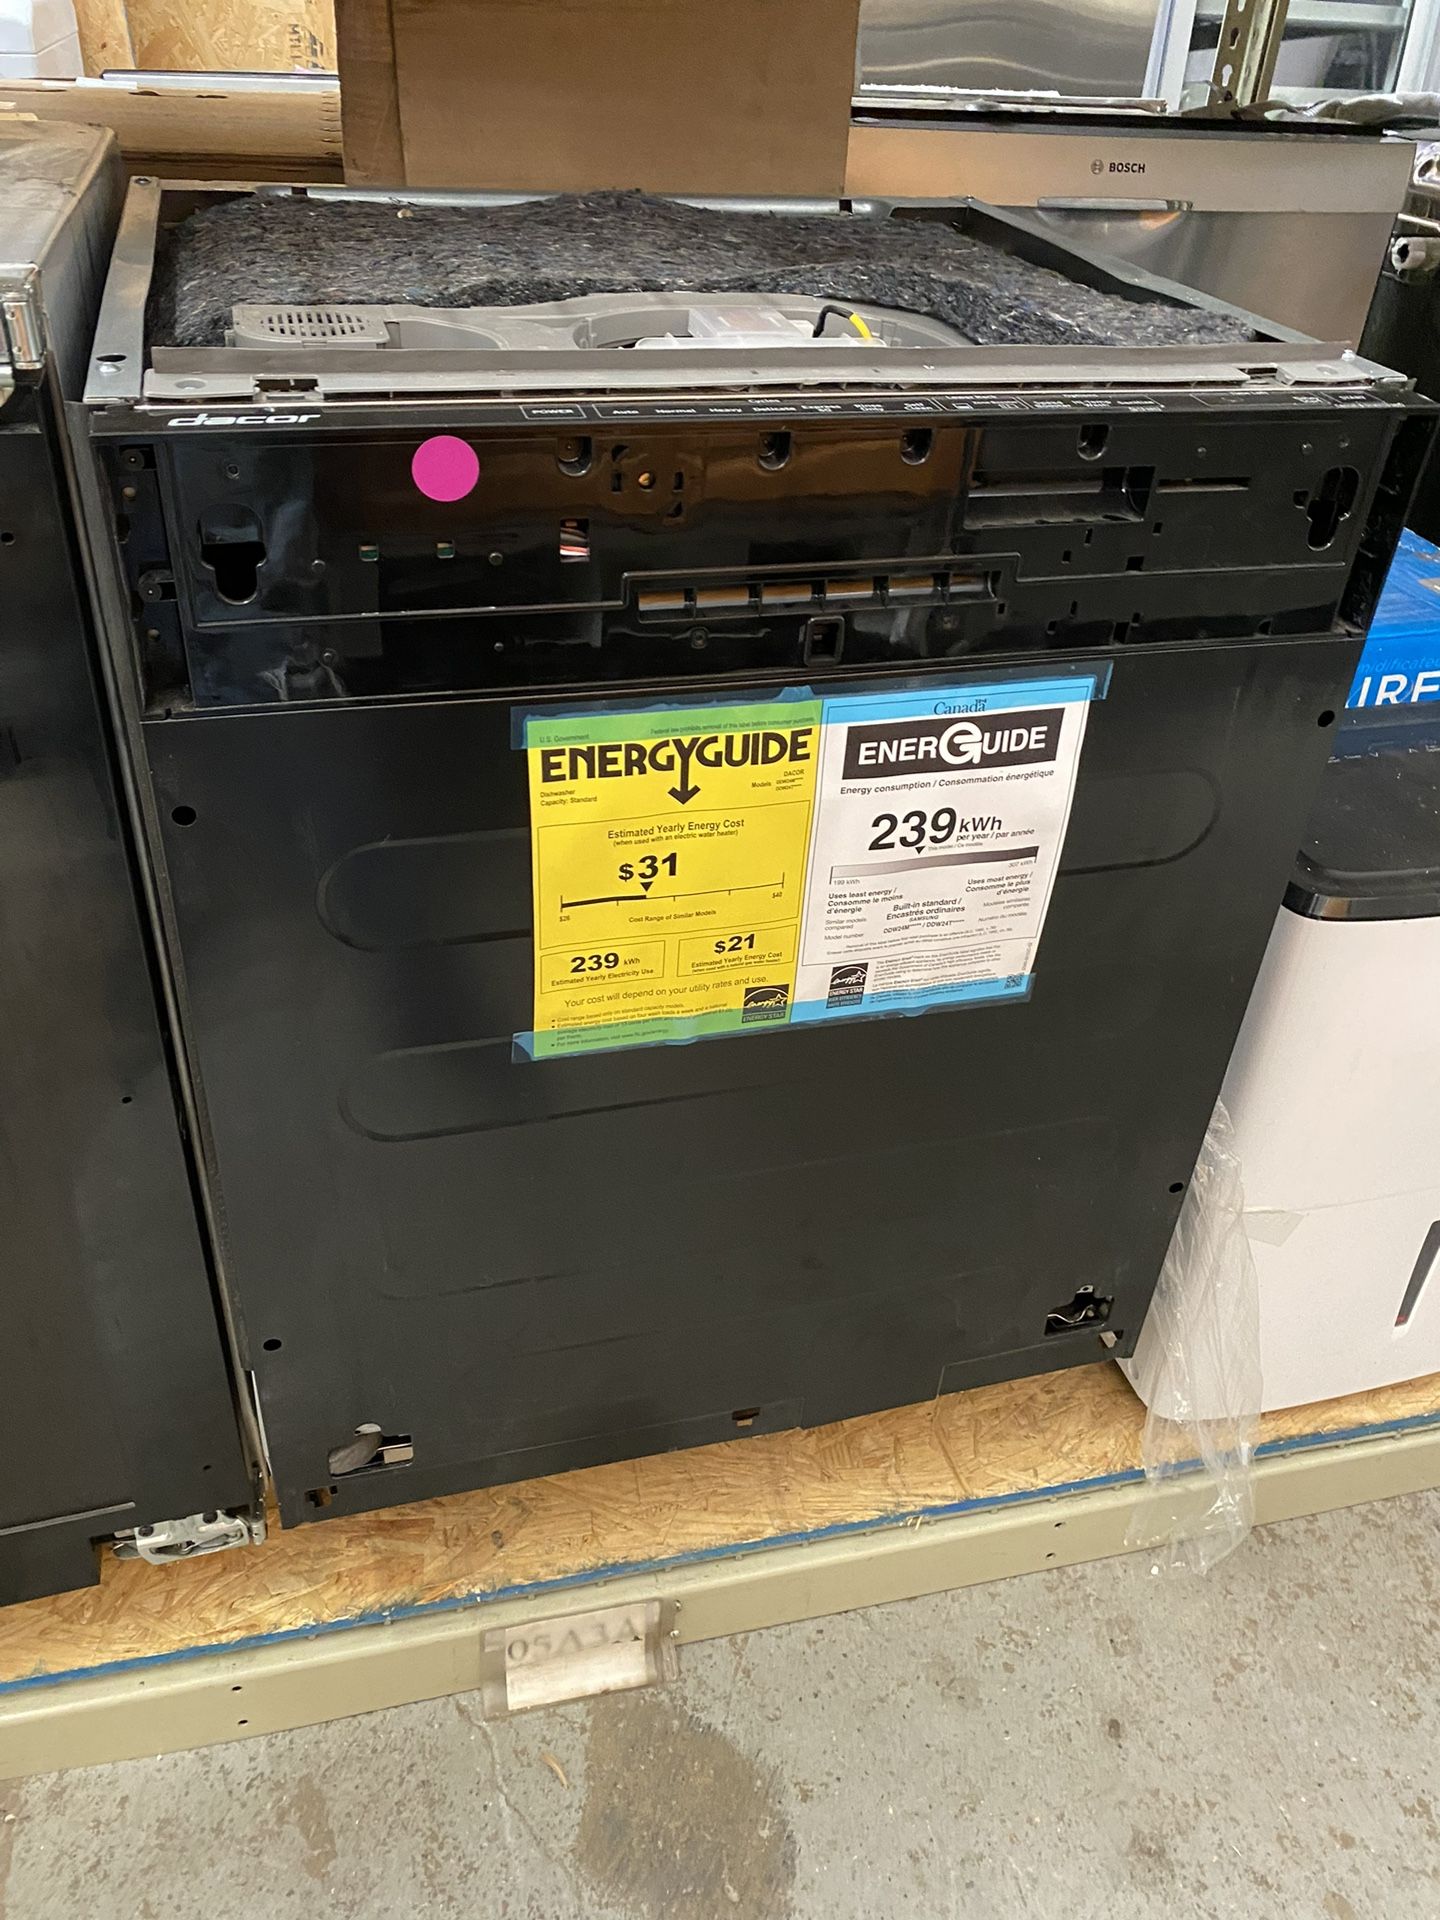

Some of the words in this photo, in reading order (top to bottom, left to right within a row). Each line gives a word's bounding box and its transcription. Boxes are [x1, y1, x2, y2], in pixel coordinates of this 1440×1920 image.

[1109, 162, 1146, 173] BOSCH
[168, 413, 321, 427] dacor
[933, 699, 987, 716] Canada
[541, 728, 812, 784] ENERGYGUIDE
[784, 768, 805, 777] DACOR
[840, 786, 872, 796] Energy
[874, 780, 931, 793] consumption
[938, 774, 1004, 787] Consommation
[1005, 768, 1055, 782] énergétique
[540, 789, 575, 798] Dishwasher
[540, 798, 568, 807] Capacity:
[570, 796, 597, 804] Standard
[608, 827, 654, 839] Estimated
[657, 823, 685, 833] Yearly
[688, 821, 721, 831] Energy
[723, 819, 745, 828] Cost
[868, 807, 958, 851] 239
[959, 816, 1003, 833] kWh
[956, 834, 972, 843] per
[973, 832, 990, 841] year
[995, 831, 1010, 840] par
[1010, 827, 1035, 837] année
[613, 839, 632, 847] (when
[674, 832, 697, 840] electric
[717, 829, 739, 837] heater)
[618, 852, 677, 882] $31
[1005, 873, 1029, 881] energy
[868, 889, 892, 897] energy
[965, 884, 1006, 893] Consomme
[1015, 880, 1031, 888] plus
[827, 899, 871, 907] Consomme
[881, 894, 903, 902] moins
[893, 902, 921, 912] Built-in
[921, 898, 957, 907] standard
[644, 914, 665, 922] Range
[695, 909, 717, 917] Models
[886, 910, 924, 921] Encastrés
[925, 906, 966, 915] ordinaires
[909, 914, 939, 923] SAMSUNG
[714, 933, 755, 954] $21
[570, 952, 620, 973] 239
[624, 957, 641, 965] kWh
[691, 959, 723, 969] Estimated
[723, 956, 743, 964] Yearly
[744, 953, 766, 961] Energy
[551, 976, 584, 986] Estimated
[586, 974, 606, 982] Yearly
[608, 970, 640, 979] Electricity
[565, 999, 585, 1008] Your
[586, 996, 605, 1005] cost
[606, 993, 620, 1001] will
[622, 989, 654, 1000] depend
[655, 988, 666, 996] on
[668, 987, 687, 996] your
[689, 983, 711, 993] utility
[712, 980, 732, 989] rates
[734, 976, 749, 986] and
[751, 976, 769, 984] use.
